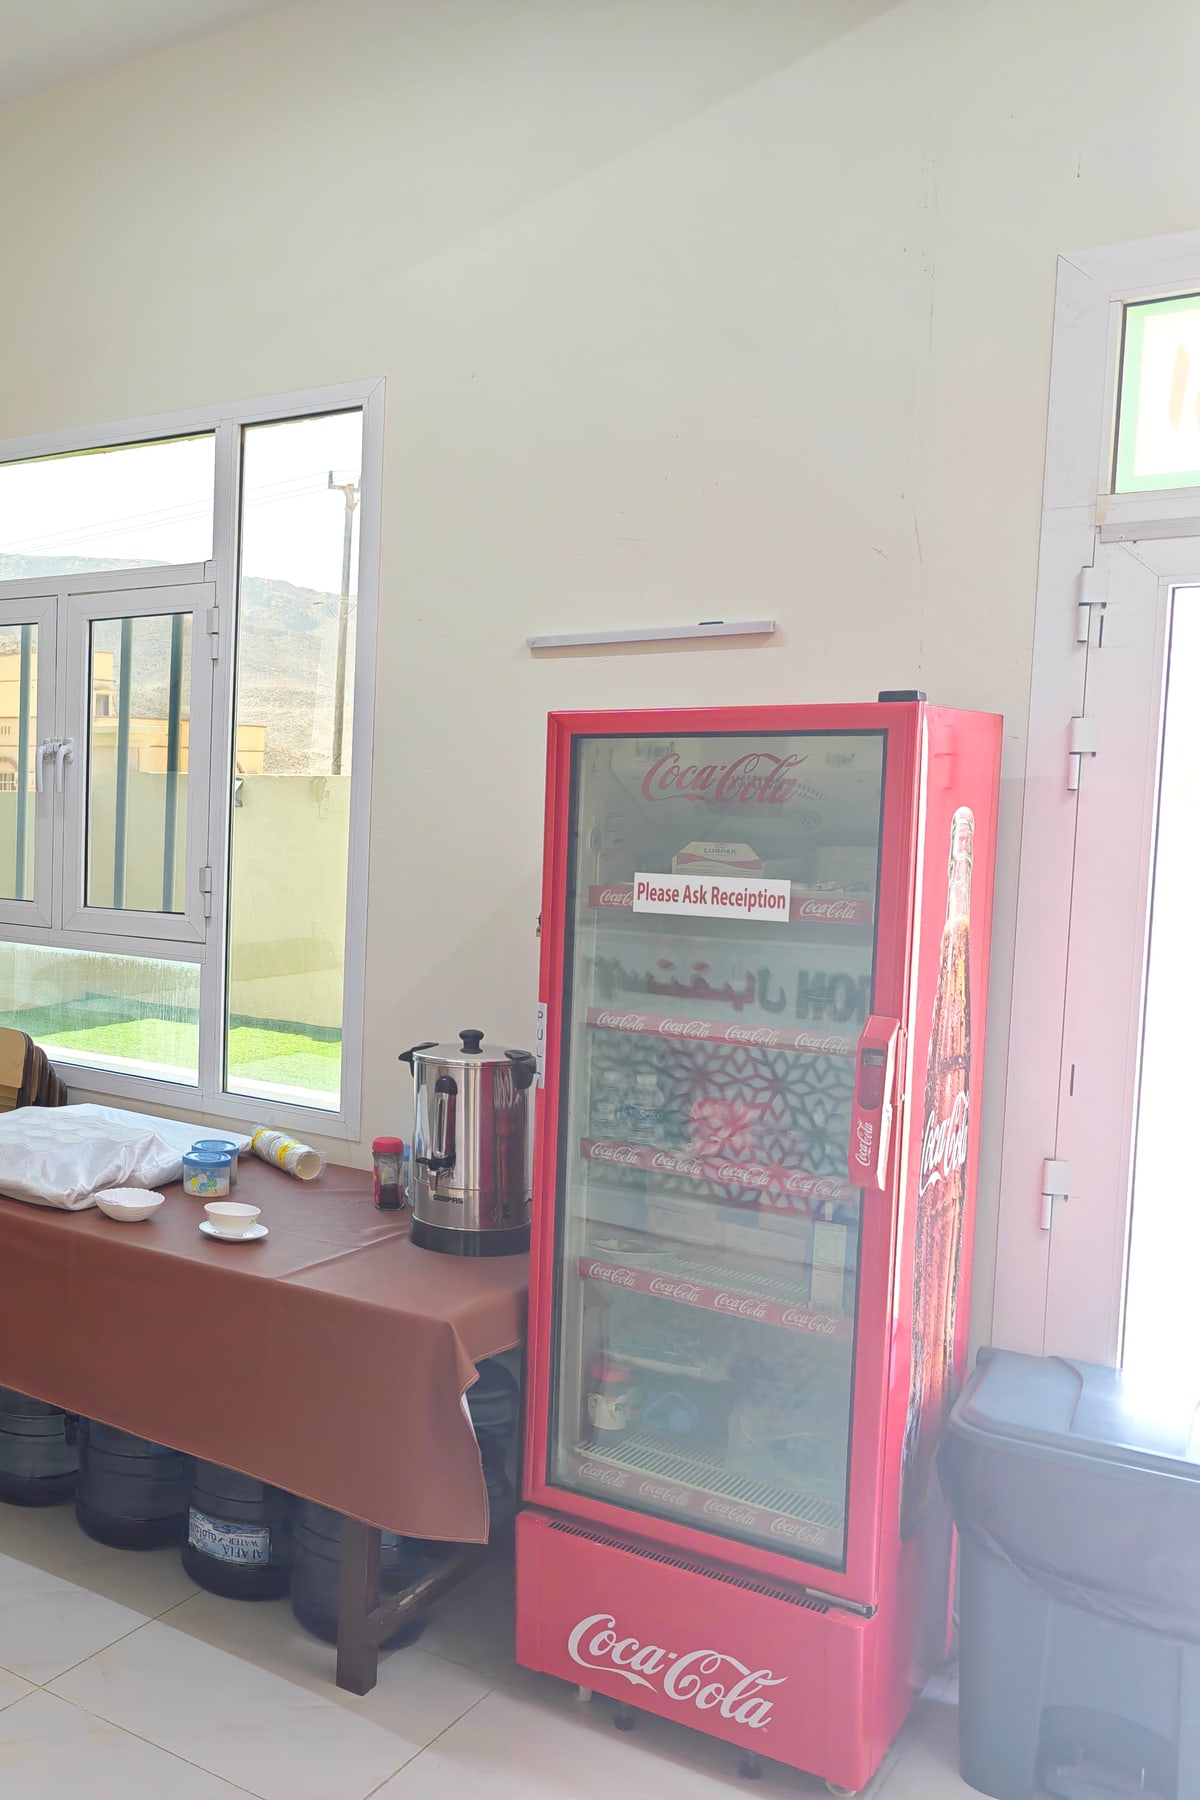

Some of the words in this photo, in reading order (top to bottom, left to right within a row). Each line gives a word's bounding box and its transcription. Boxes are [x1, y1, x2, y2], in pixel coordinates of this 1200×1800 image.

[641, 753, 808, 804] Coca-Cola
[636, 882, 680, 904] Please
[682, 884, 708, 905] Ask
[711, 886, 786, 912] Receiption
[228, 1537, 259, 1548] WATER
[568, 1613, 788, 1728] Coca-Cola
